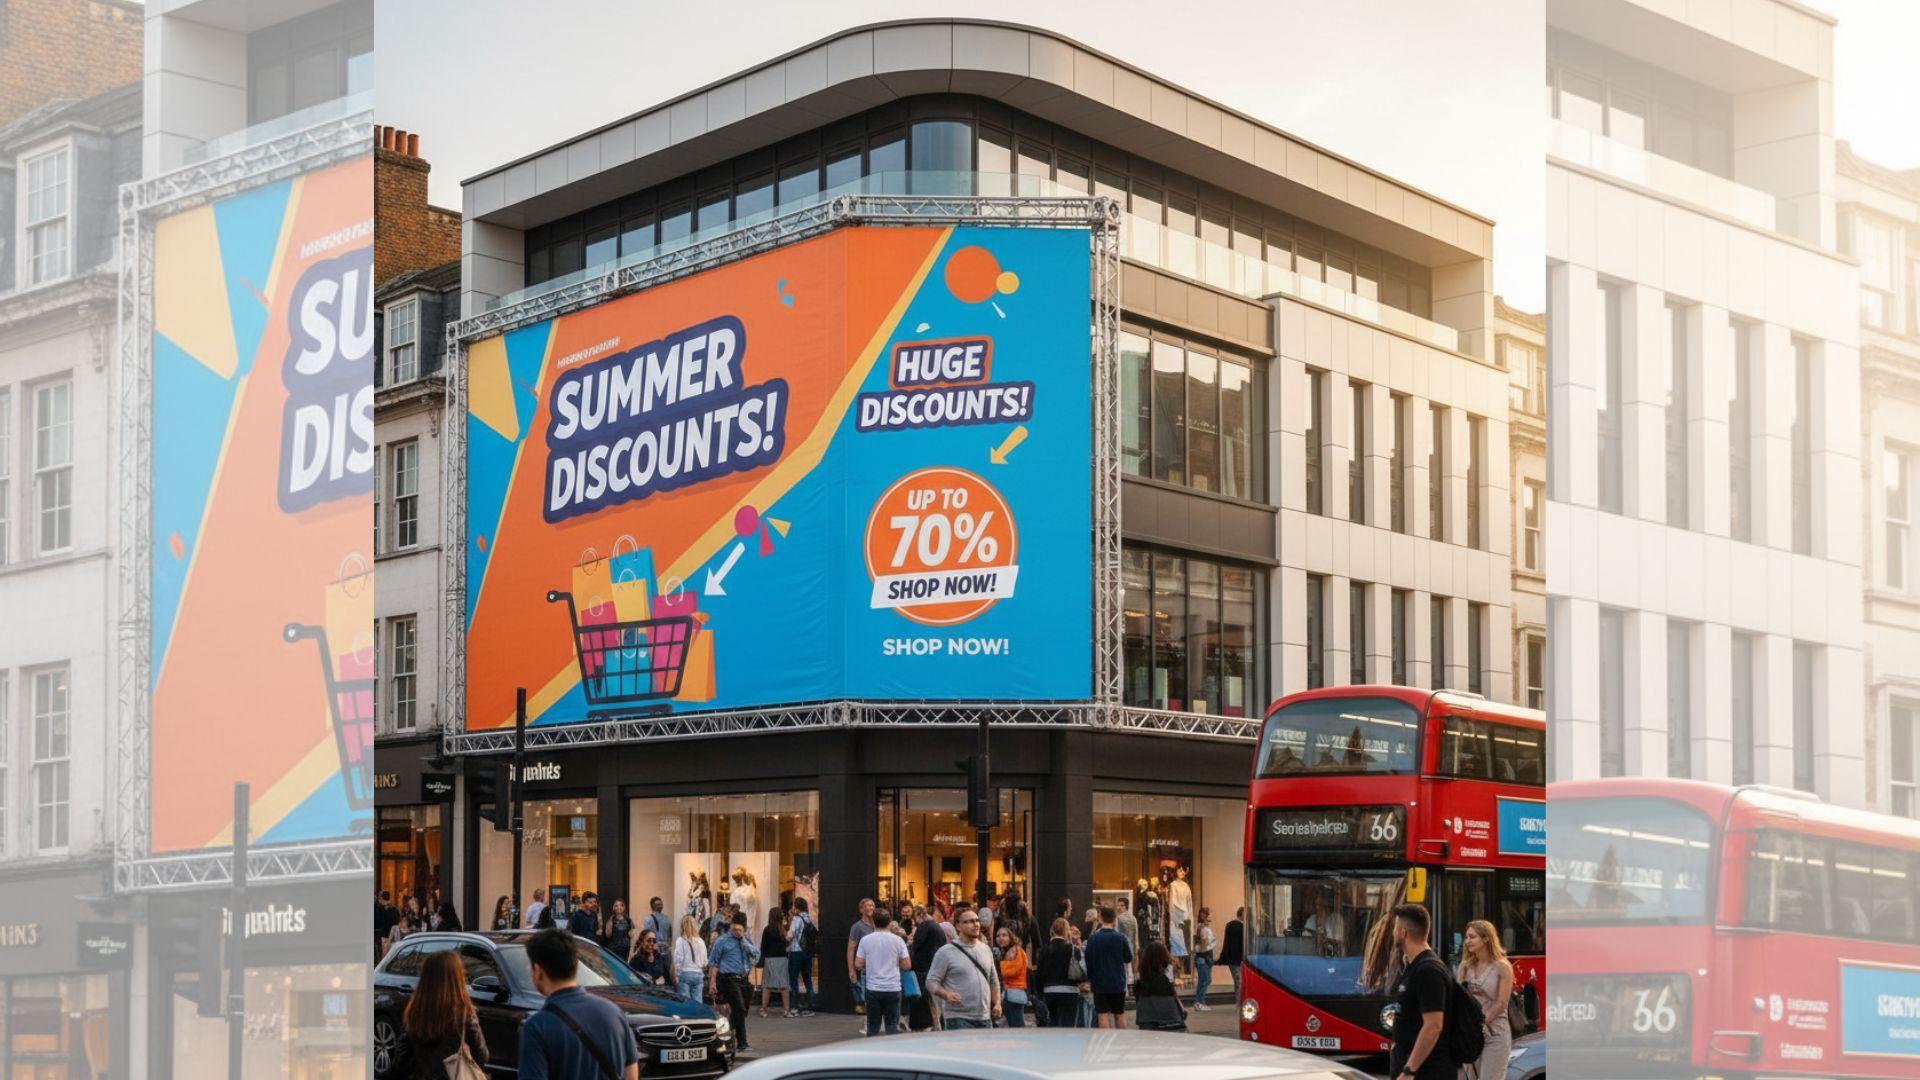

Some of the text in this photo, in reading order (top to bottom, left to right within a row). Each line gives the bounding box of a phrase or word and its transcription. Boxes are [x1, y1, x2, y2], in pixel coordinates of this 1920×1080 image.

[898, 345, 983, 382] HUGE
[553, 328, 736, 440] SUMMER
[860, 386, 1029, 427] DISCOUNTS!
[550, 391, 778, 512] DISCOUNTS!
[907, 487, 968, 510] UP TO
[890, 511, 998, 567] 70%
[888, 573, 997, 600] SHOP NOW!
[882, 637, 1009, 656] SHOP NOW!
